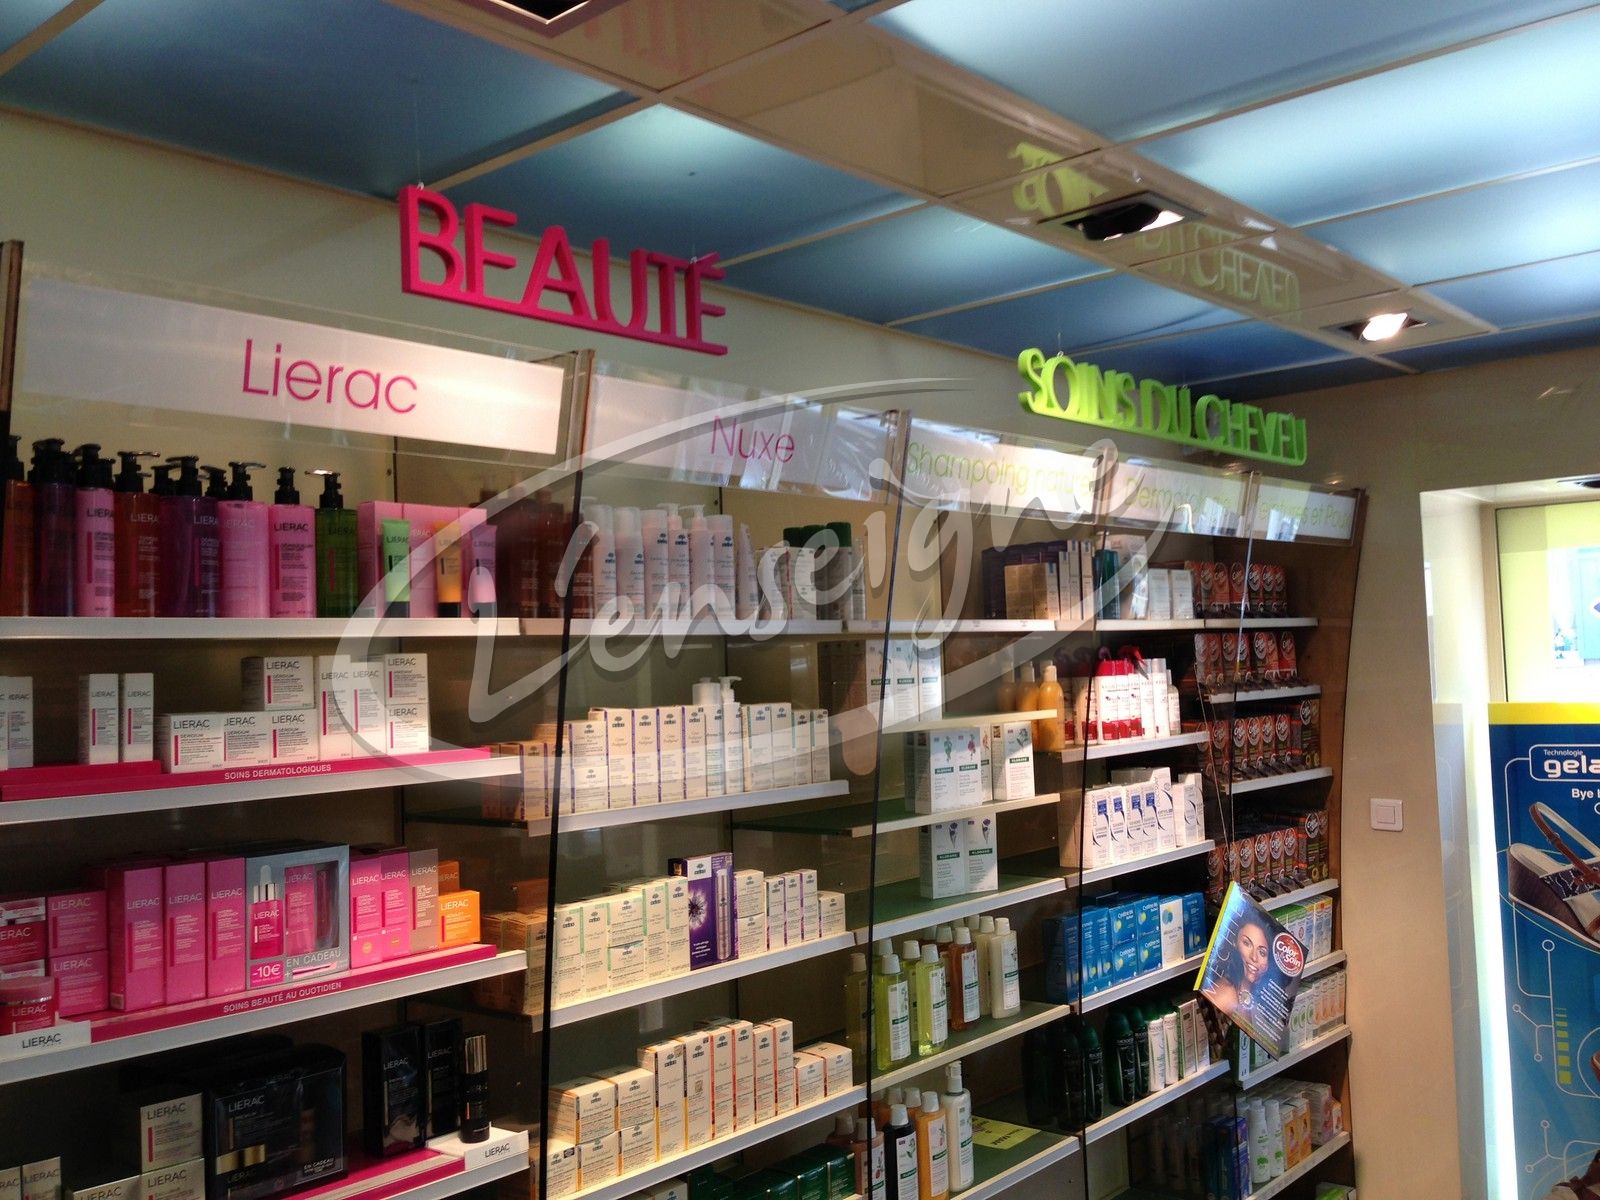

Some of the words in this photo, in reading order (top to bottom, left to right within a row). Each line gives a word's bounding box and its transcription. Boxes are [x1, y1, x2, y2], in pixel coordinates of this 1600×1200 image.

[397, 184, 727, 356] BEAUTÉ
[242, 338, 418, 414] Lierac
[1018, 348, 1138, 432] SOINS
[1140, 378, 1193, 440] DU
[1194, 394, 1307, 466] CHEVEU
[710, 415, 795, 464] Nuxe
[907, 441, 1030, 496] Shampoing
[86, 507, 114, 518] LIERA
[130, 512, 160, 524] LIERA
[193, 514, 218, 525] LIERA
[273, 521, 309, 532] LIERAC
[266, 660, 301, 670] LIERAC
[388, 657, 417, 667] LIERAC
[321, 671, 349, 680] LIERAC
[352, 669, 380, 679] LIERAC
[91, 690, 116, 698] LIERAC
[127, 690, 152, 698] LIERAC
[271, 713, 305, 724] LIERAC
[389, 707, 418, 717] LIERAC
[173, 719, 211, 730] LIERAC
[1543, 749, 1584, 757] Technologie
[224, 770, 251, 780] SOINS
[252, 764, 332, 779] DERMATOLOGIQUES
[1543, 754, 1600, 779] gela
[1571, 787, 1594, 801] Bye
[380, 869, 407, 881] LIERAC
[412, 864, 437, 876] LIERAC
[352, 873, 379, 886] LIERAC
[168, 892, 203, 905] LIERAC
[211, 887, 244, 900] LIERAC
[51, 898, 91, 911] LIERAC
[127, 897, 161, 910] LIERAC
[440, 899, 470, 911] LIERAC
[253, 909, 280, 920] LIERAC
[0, 927, 32, 940] ERAC
[1276, 940, 1297, 958] Color
[53, 957, 94, 972] LIERAC
[286, 957, 302, 969] EN
[303, 949, 342, 964] CADEAU
[1284, 953, 1302, 968] Soin
[251, 963, 281, 978] -10€
[223, 1001, 250, 1014] SOINS
[251, 991, 284, 1008] BEAUTÉ
[285, 990, 298, 1001] AU
[299, 982, 342, 998] QUOTIDIEN
[11, 1004, 48, 1018] LIERAC
[22, 1033, 62, 1049] LIERAC
[383, 1057, 409, 1071] LIERAC
[228, 1095, 265, 1113] LIERAC
[146, 1102, 187, 1120] LIERAC
[484, 1142, 511, 1159] LIERAC
[147, 1169, 187, 1188] LIERAC
